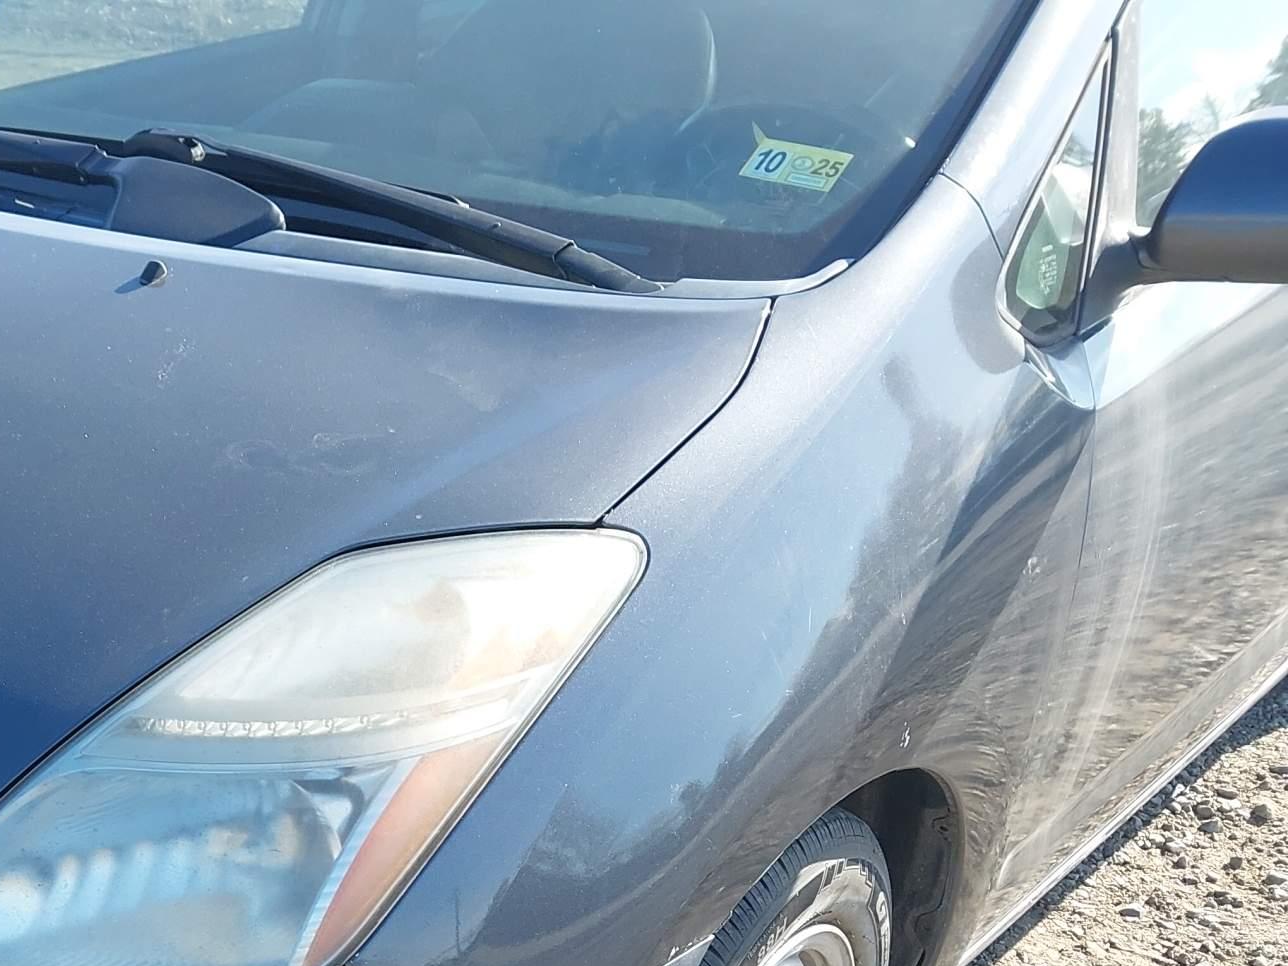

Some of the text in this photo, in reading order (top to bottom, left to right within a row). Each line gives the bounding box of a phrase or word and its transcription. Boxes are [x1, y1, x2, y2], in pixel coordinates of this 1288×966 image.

[755, 149, 844, 178] 10 25
[757, 915, 789, 964] 88H
